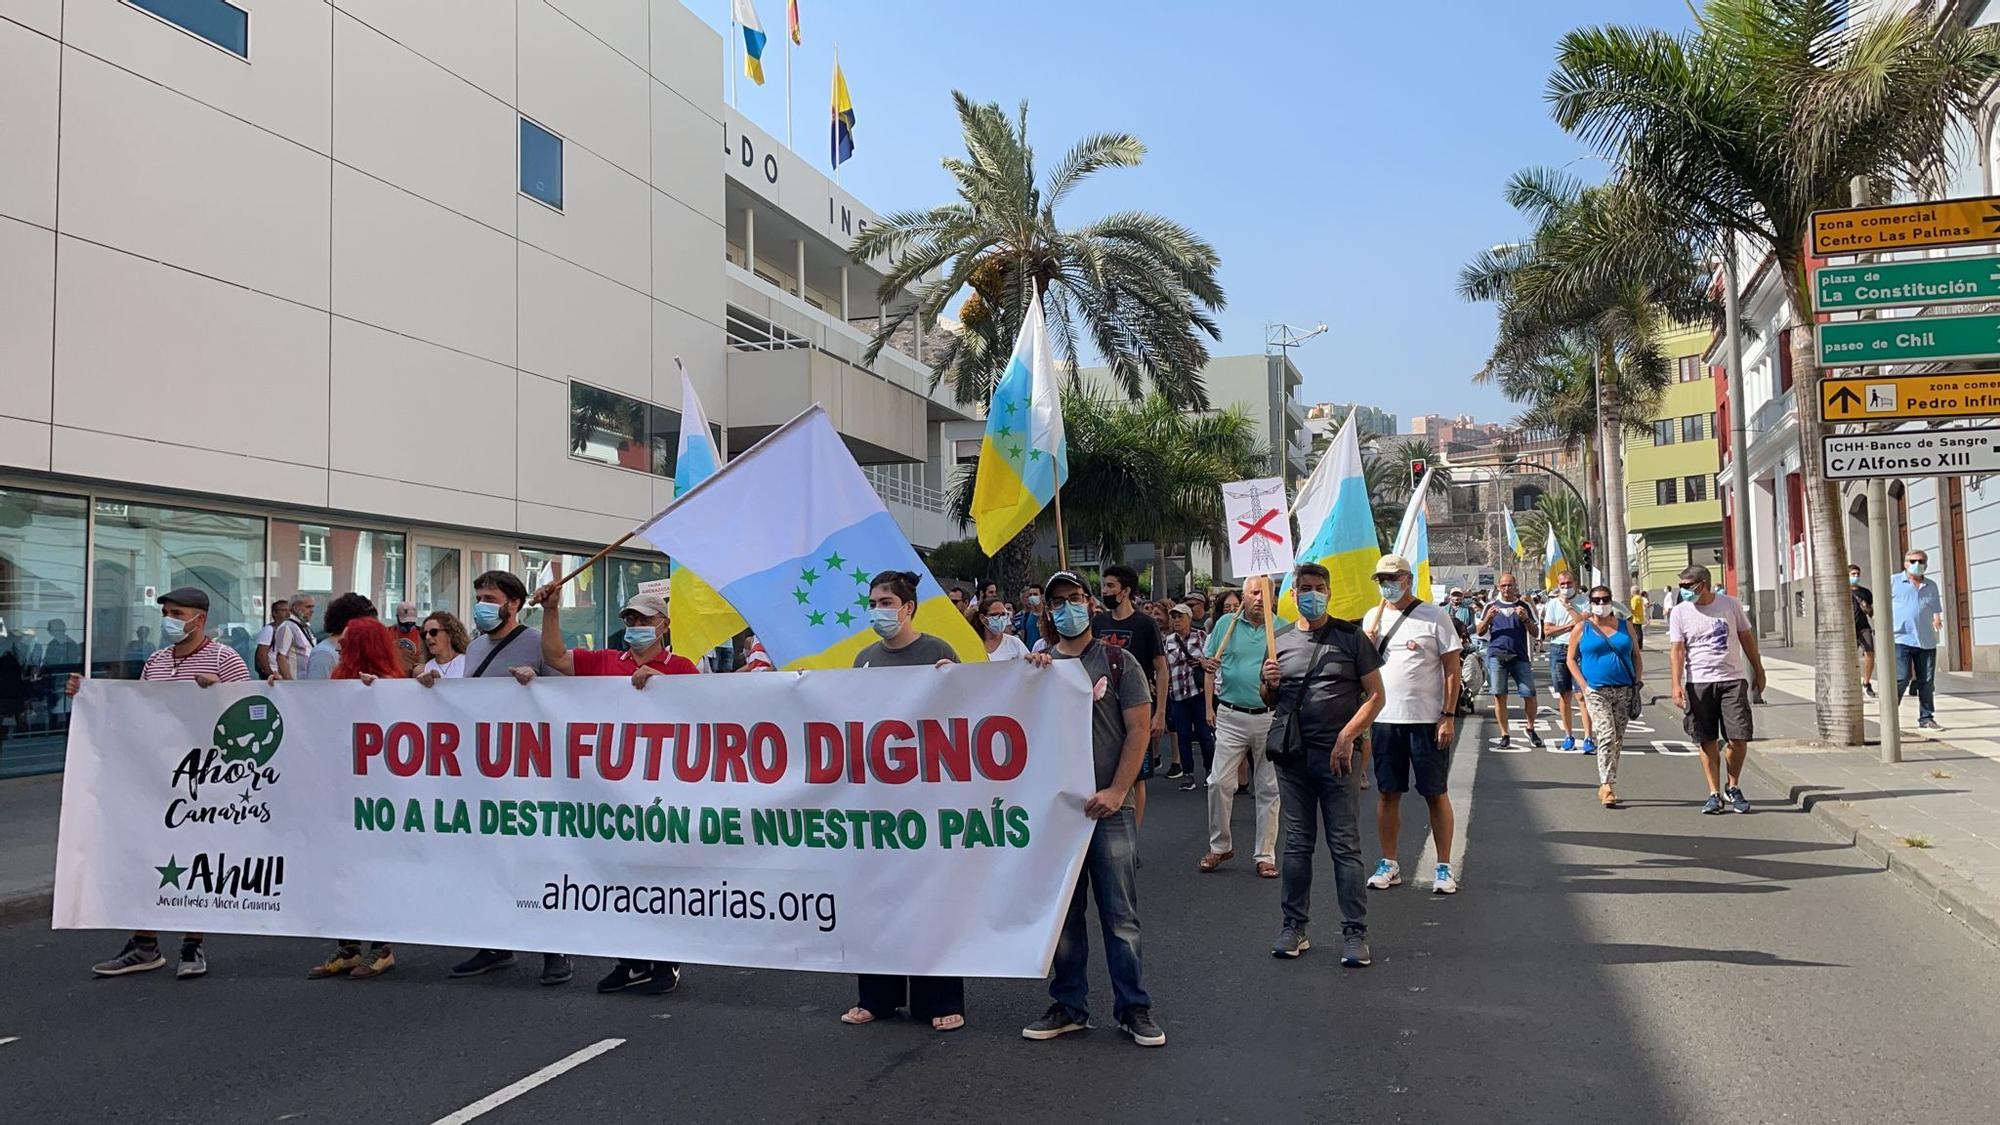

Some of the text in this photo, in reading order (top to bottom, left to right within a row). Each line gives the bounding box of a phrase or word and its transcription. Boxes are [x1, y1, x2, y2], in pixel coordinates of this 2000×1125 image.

[1819, 210, 1937, 231] zona comercial
[1820, 225, 1971, 247] Centro Las Palmas
[1822, 271, 1880, 286] plaza de
[1822, 279, 1978, 303] La Constitución
[1825, 331, 1935, 354] paseo de Chil
[1929, 382, 1959, 392] zona
[1907, 397, 1957, 410] Pedro
[1830, 435, 1988, 453] ICHH-Banco de Sangre
[1831, 452, 1971, 472] C/Alfonso XIII
[352, 715, 1028, 785] POR UN FUTURO DIGNO
[172, 748, 280, 801] Ahora
[165, 798, 271, 829] Canarias
[354, 796, 1030, 850] NO A LA DESTRUCCIÓN DE NUESTRO PAÍS
[156, 895, 281, 911] Juventudes Ahora Canarias
[516, 874, 836, 932] www.ahoracanarias.org
